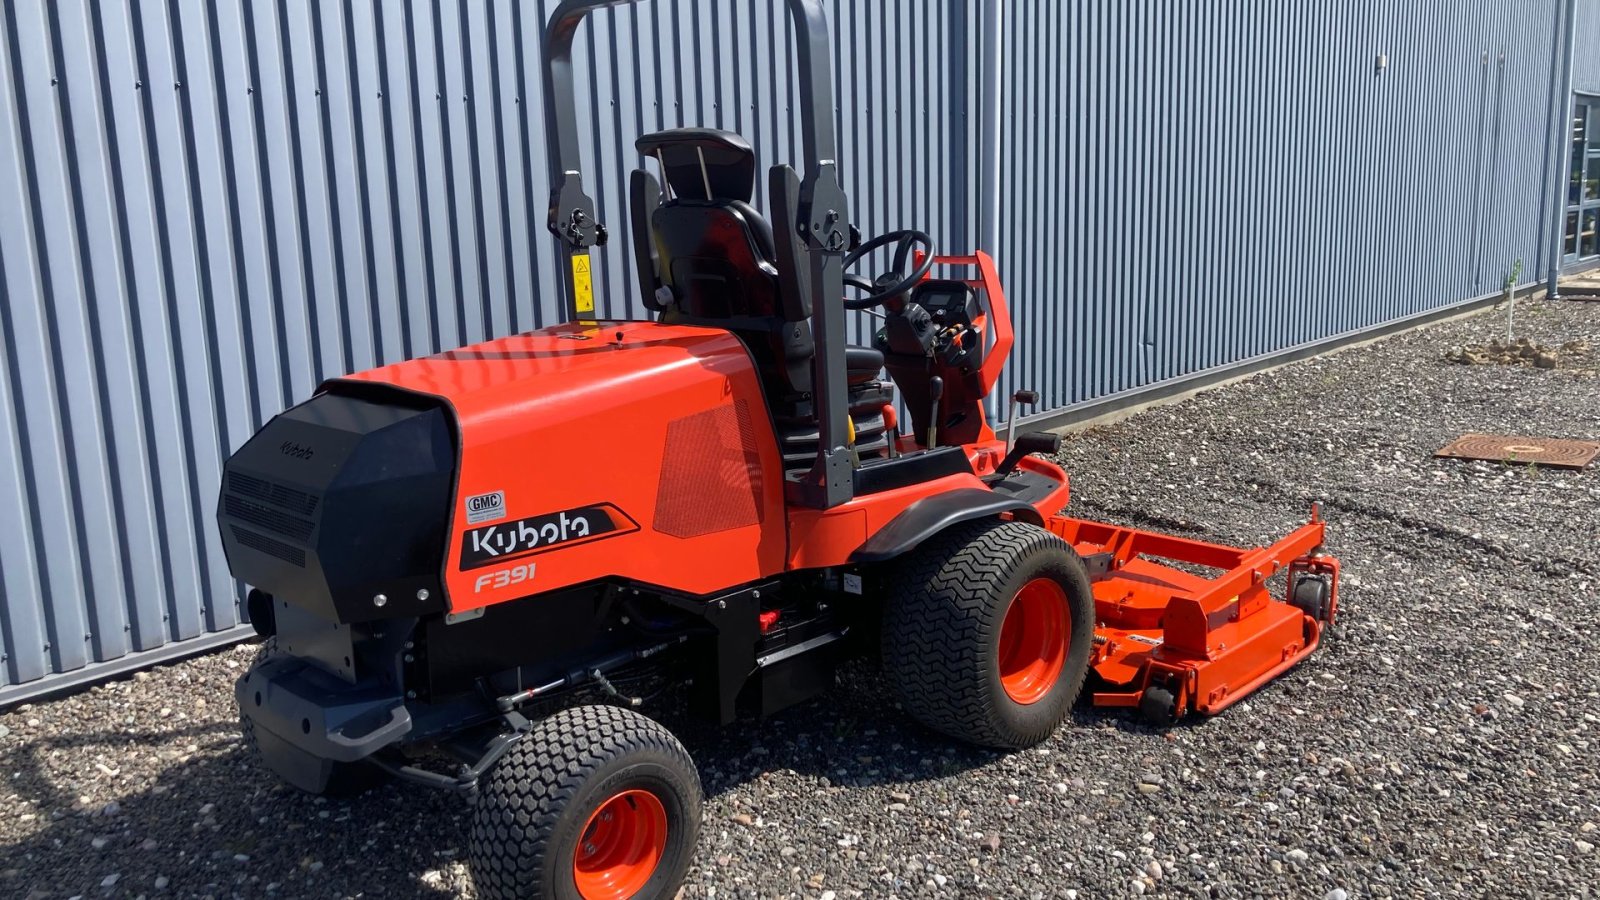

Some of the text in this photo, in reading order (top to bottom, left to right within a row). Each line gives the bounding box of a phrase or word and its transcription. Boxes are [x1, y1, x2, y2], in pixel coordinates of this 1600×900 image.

[280, 440, 313, 460] Kubota
[473, 495, 498, 510] GMC
[472, 512, 589, 556] Kubota
[474, 563, 536, 594] F391
